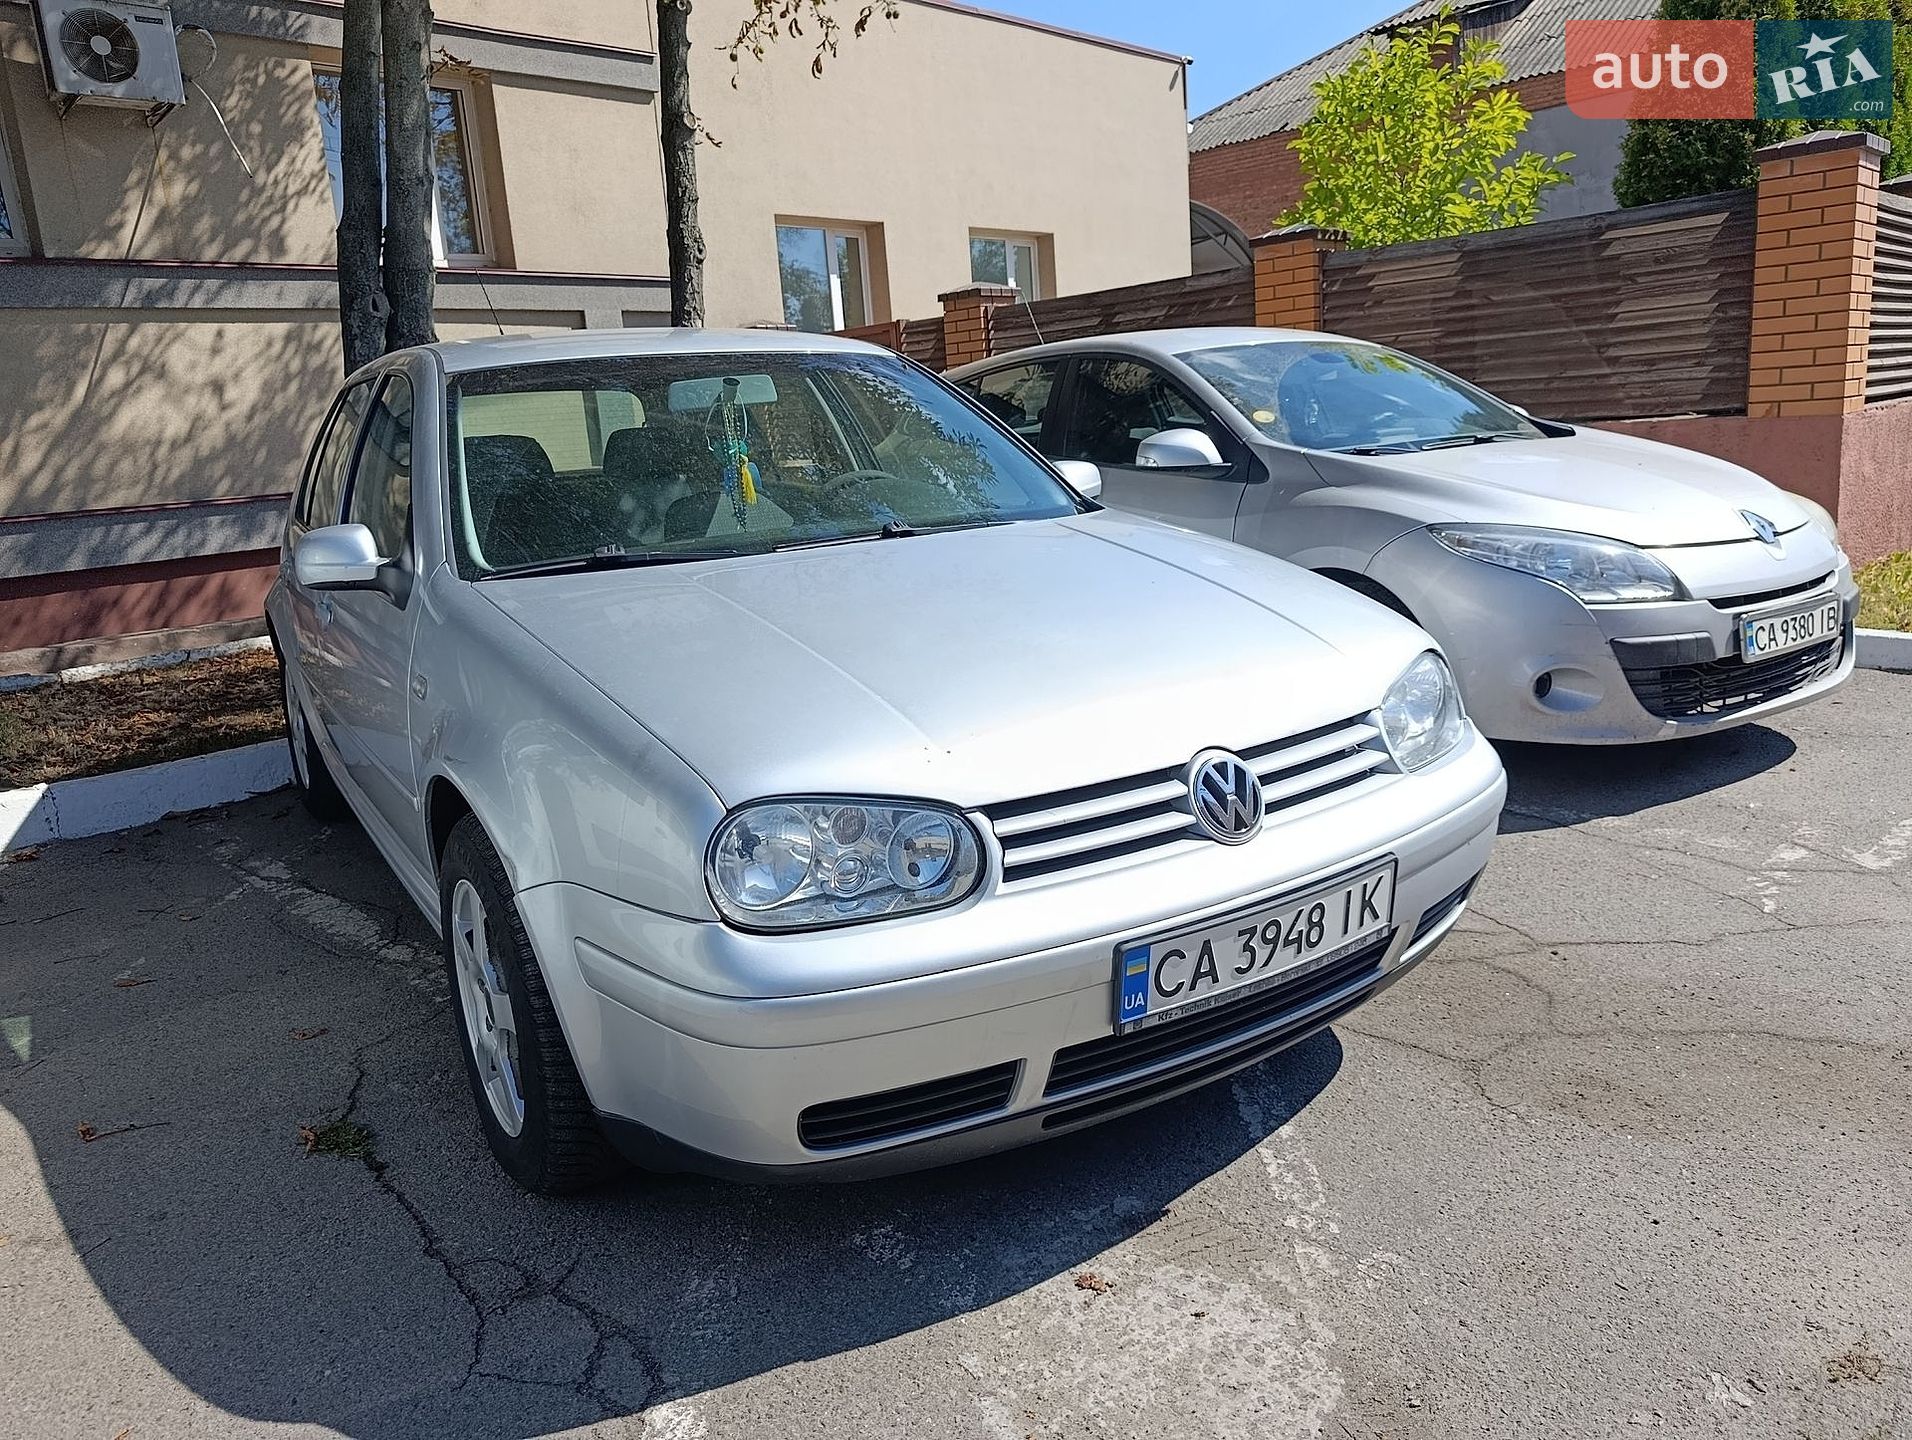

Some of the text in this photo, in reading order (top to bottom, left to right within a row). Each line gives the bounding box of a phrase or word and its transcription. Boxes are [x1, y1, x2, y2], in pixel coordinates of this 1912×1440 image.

[1754, 606, 1837, 652] CA 9380 IB
[1153, 938, 1221, 999] CA
[1234, 900, 1327, 976] 3948
[1342, 874, 1385, 936] IK
[1124, 991, 1146, 1011] UA
